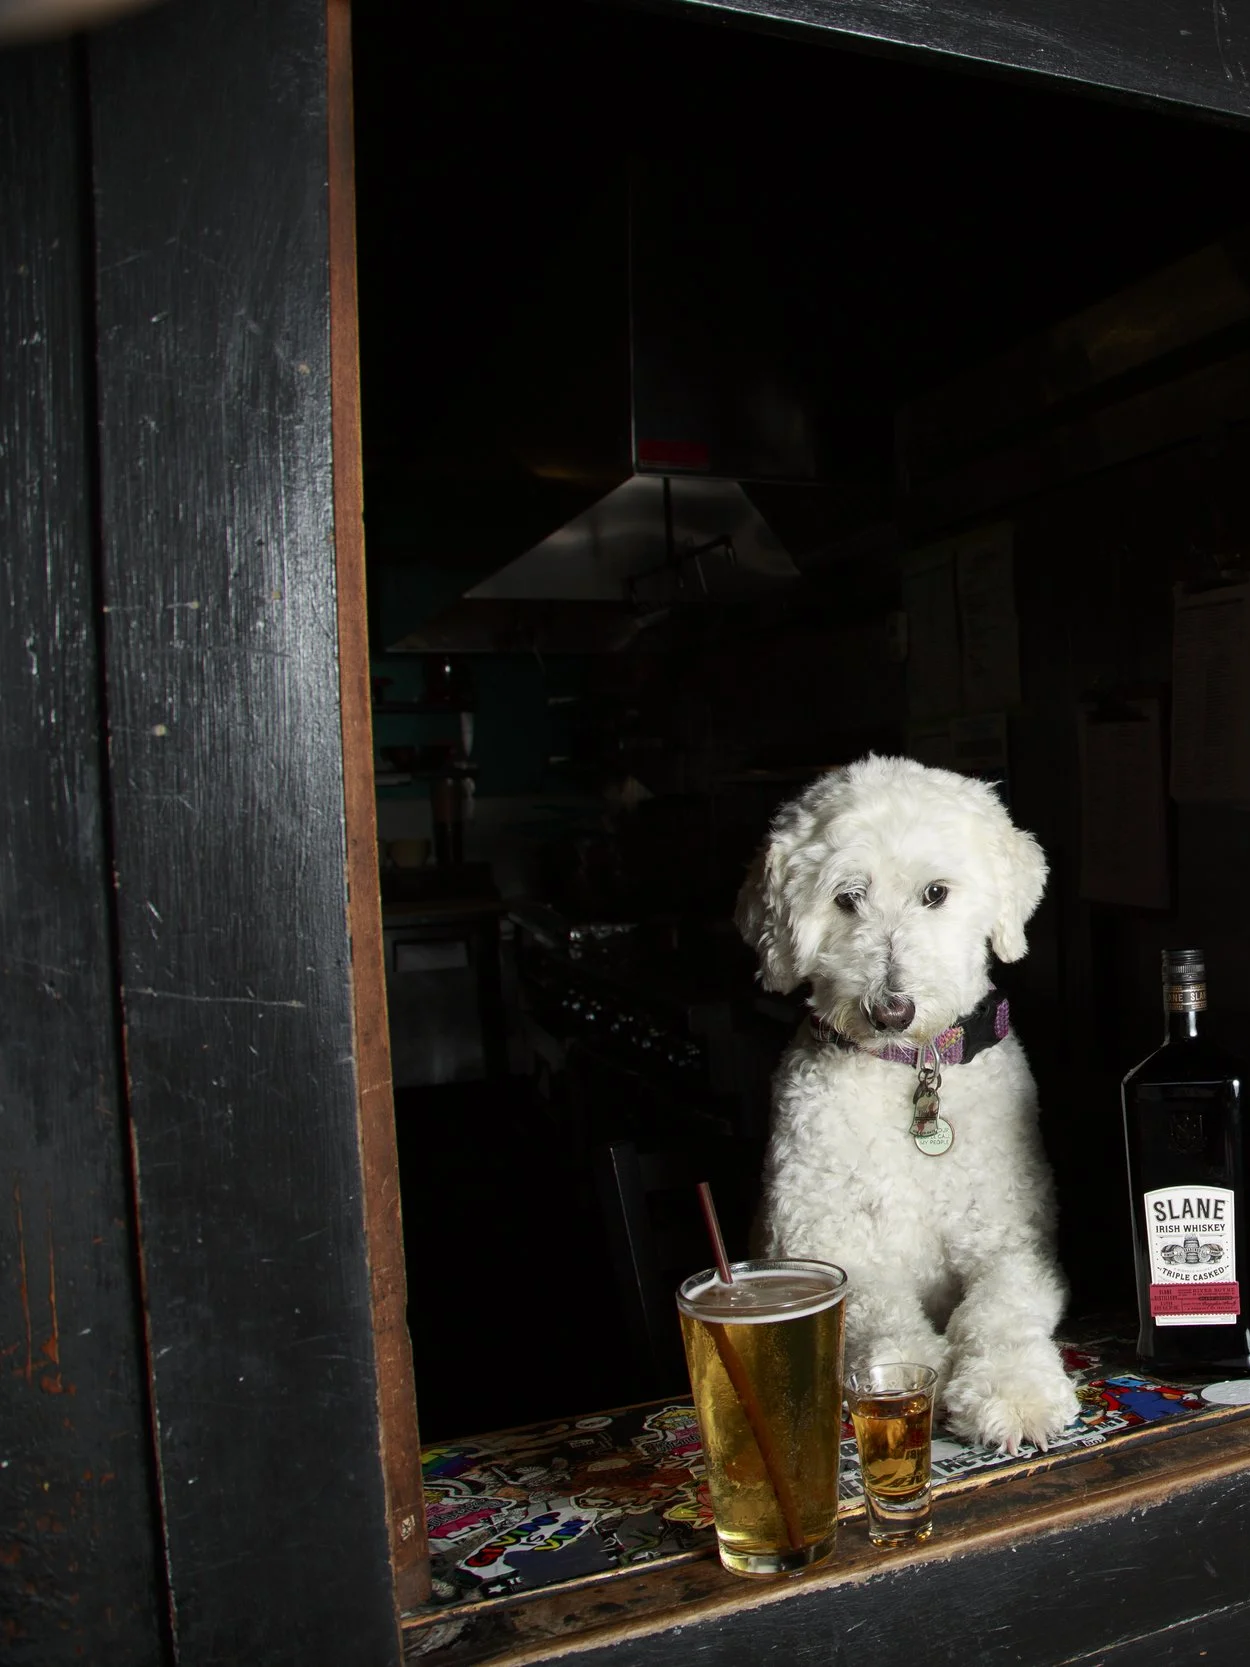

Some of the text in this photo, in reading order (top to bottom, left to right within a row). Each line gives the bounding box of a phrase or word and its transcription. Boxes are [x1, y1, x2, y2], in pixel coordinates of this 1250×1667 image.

[1153, 1197, 1226, 1222] SLANE
[1155, 1223, 1226, 1233] IRISH WHISKEY
[1162, 1267, 1191, 1281] TRIPLE
[1192, 1266, 1225, 1281] CASKED
